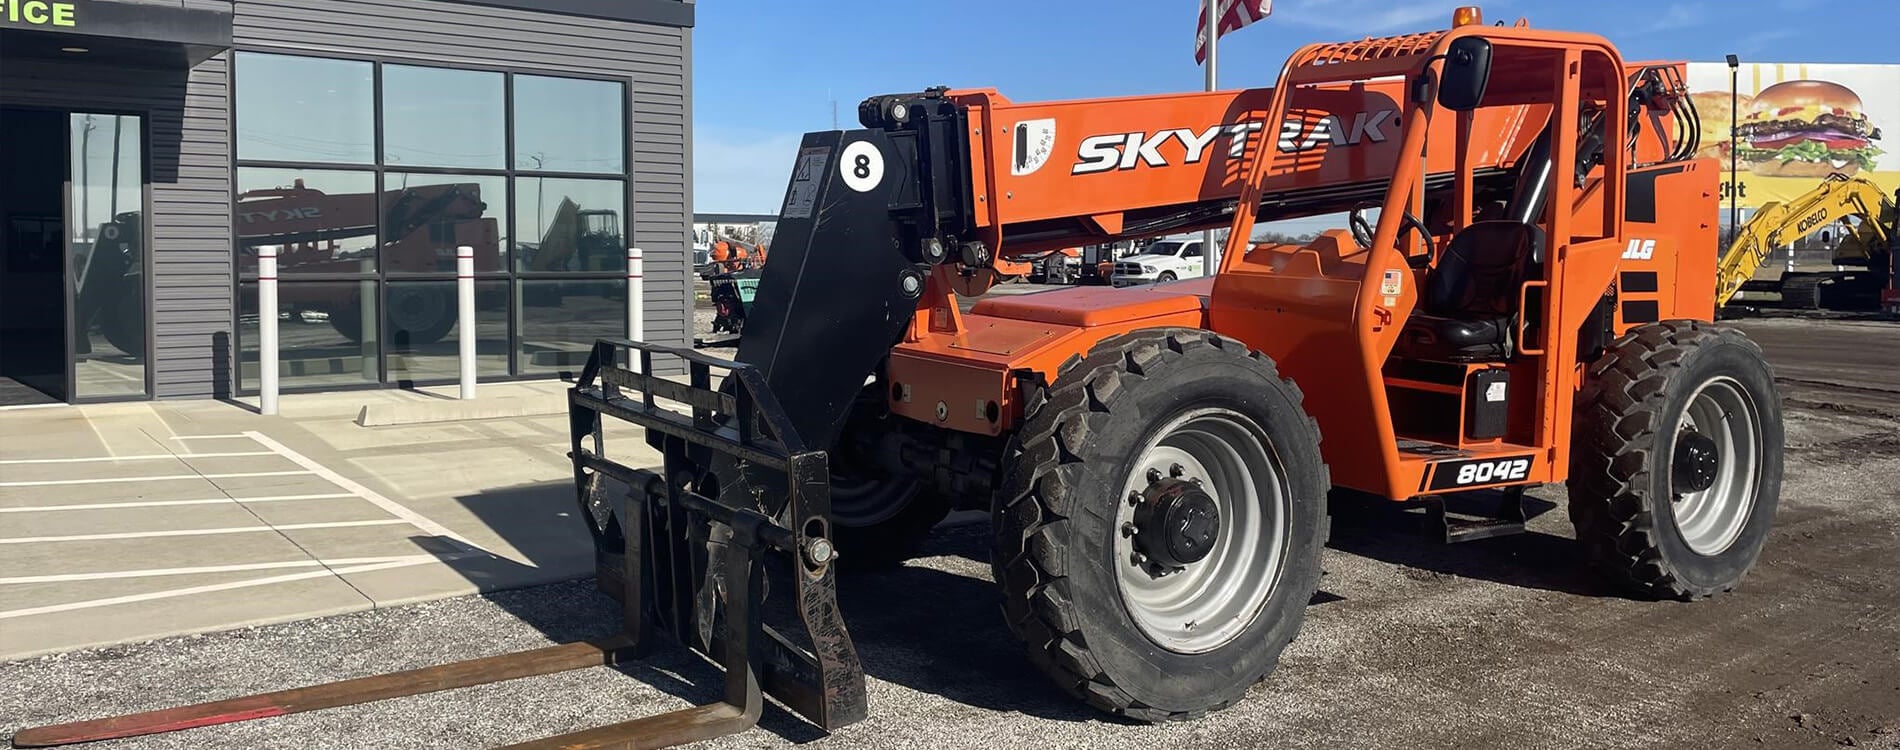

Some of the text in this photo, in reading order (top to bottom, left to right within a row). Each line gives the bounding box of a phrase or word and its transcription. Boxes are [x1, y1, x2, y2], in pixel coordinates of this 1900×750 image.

[0, 0, 76, 27] ICE
[1071, 109, 1393, 176] SKYTRAK
[853, 153, 871, 179] 8
[1796, 206, 1828, 235] KOBELCO
[1621, 238, 1657, 260] JLG
[1456, 459, 1529, 485] 8042
